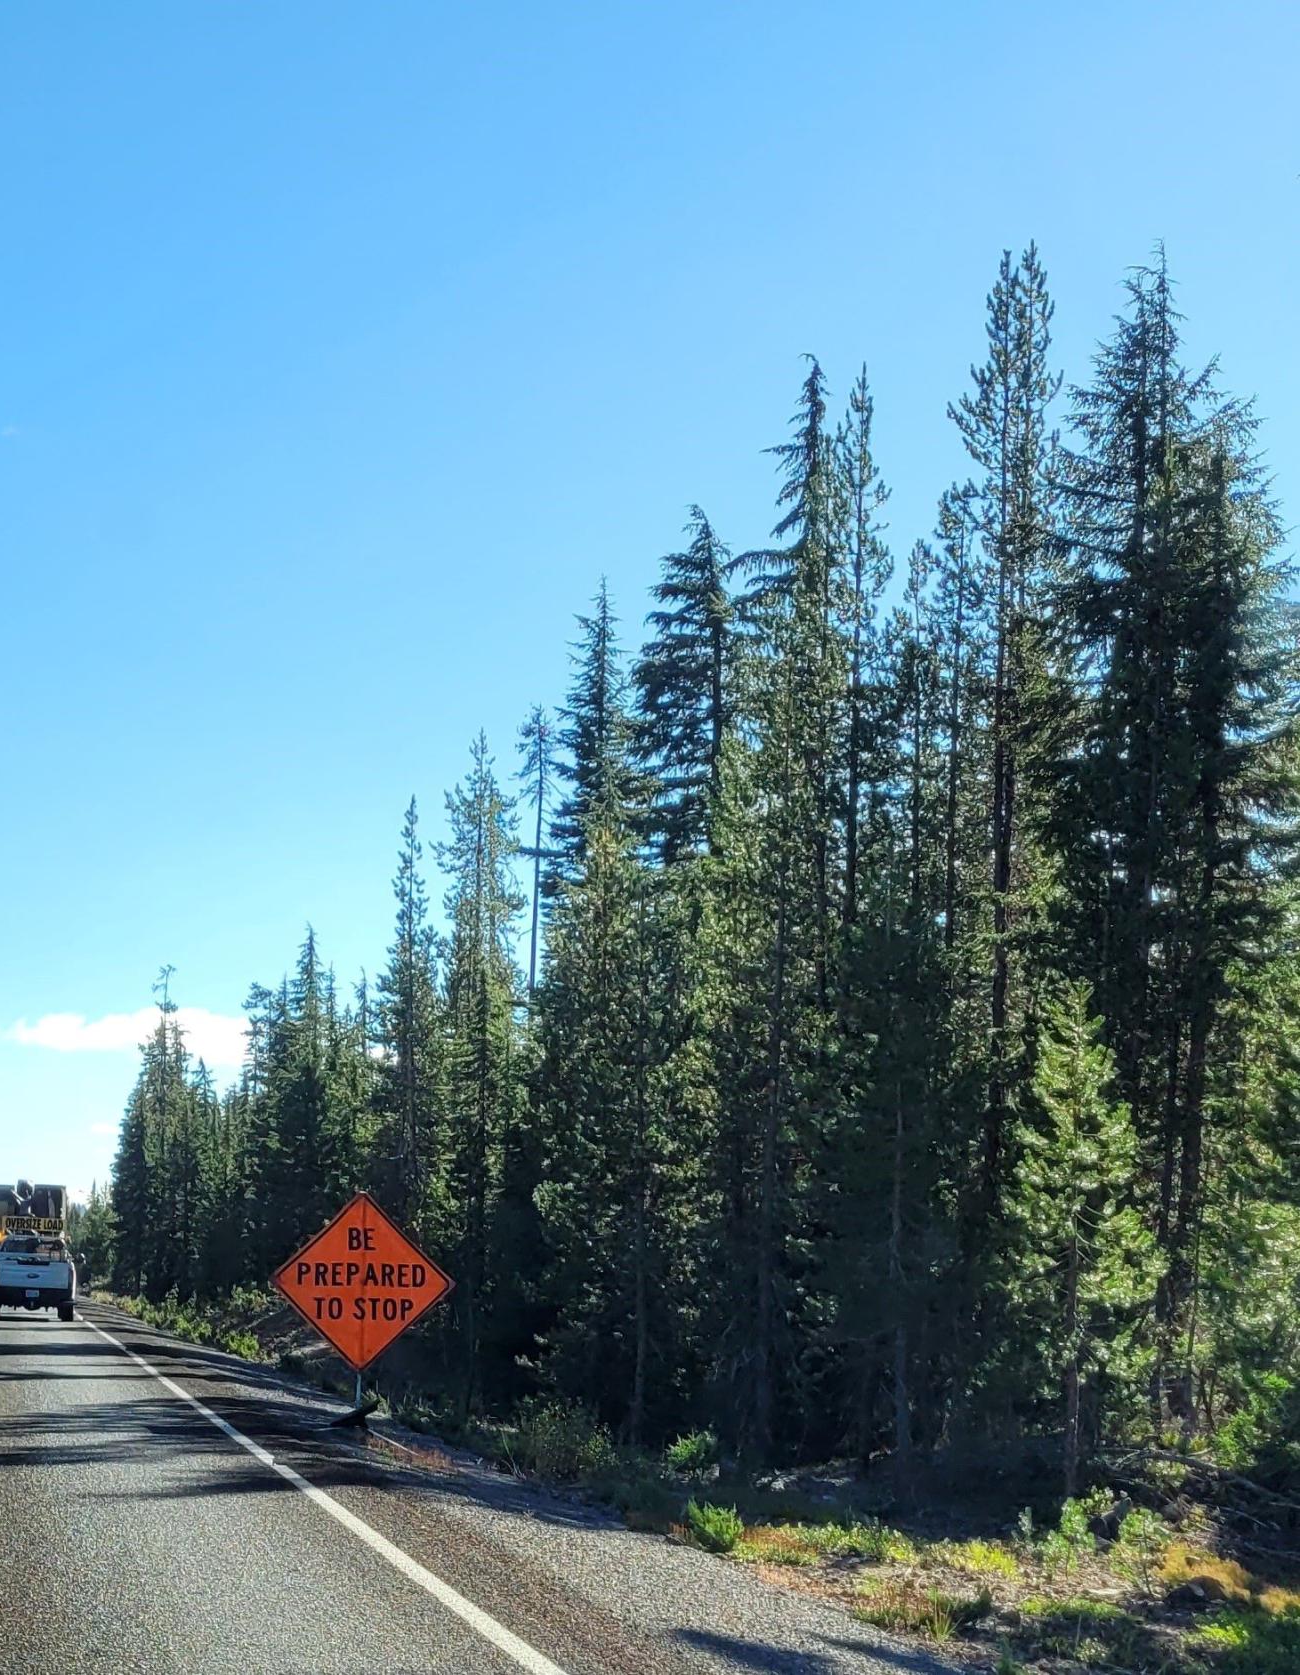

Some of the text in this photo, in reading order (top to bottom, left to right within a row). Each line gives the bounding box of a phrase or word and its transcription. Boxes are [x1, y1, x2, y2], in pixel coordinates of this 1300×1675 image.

[5, 1218, 64, 1230] OVERSIZE LOAD
[347, 1228, 376, 1251] BE
[297, 1263, 426, 1288] PREPARED
[313, 1297, 414, 1321] TO STOP
